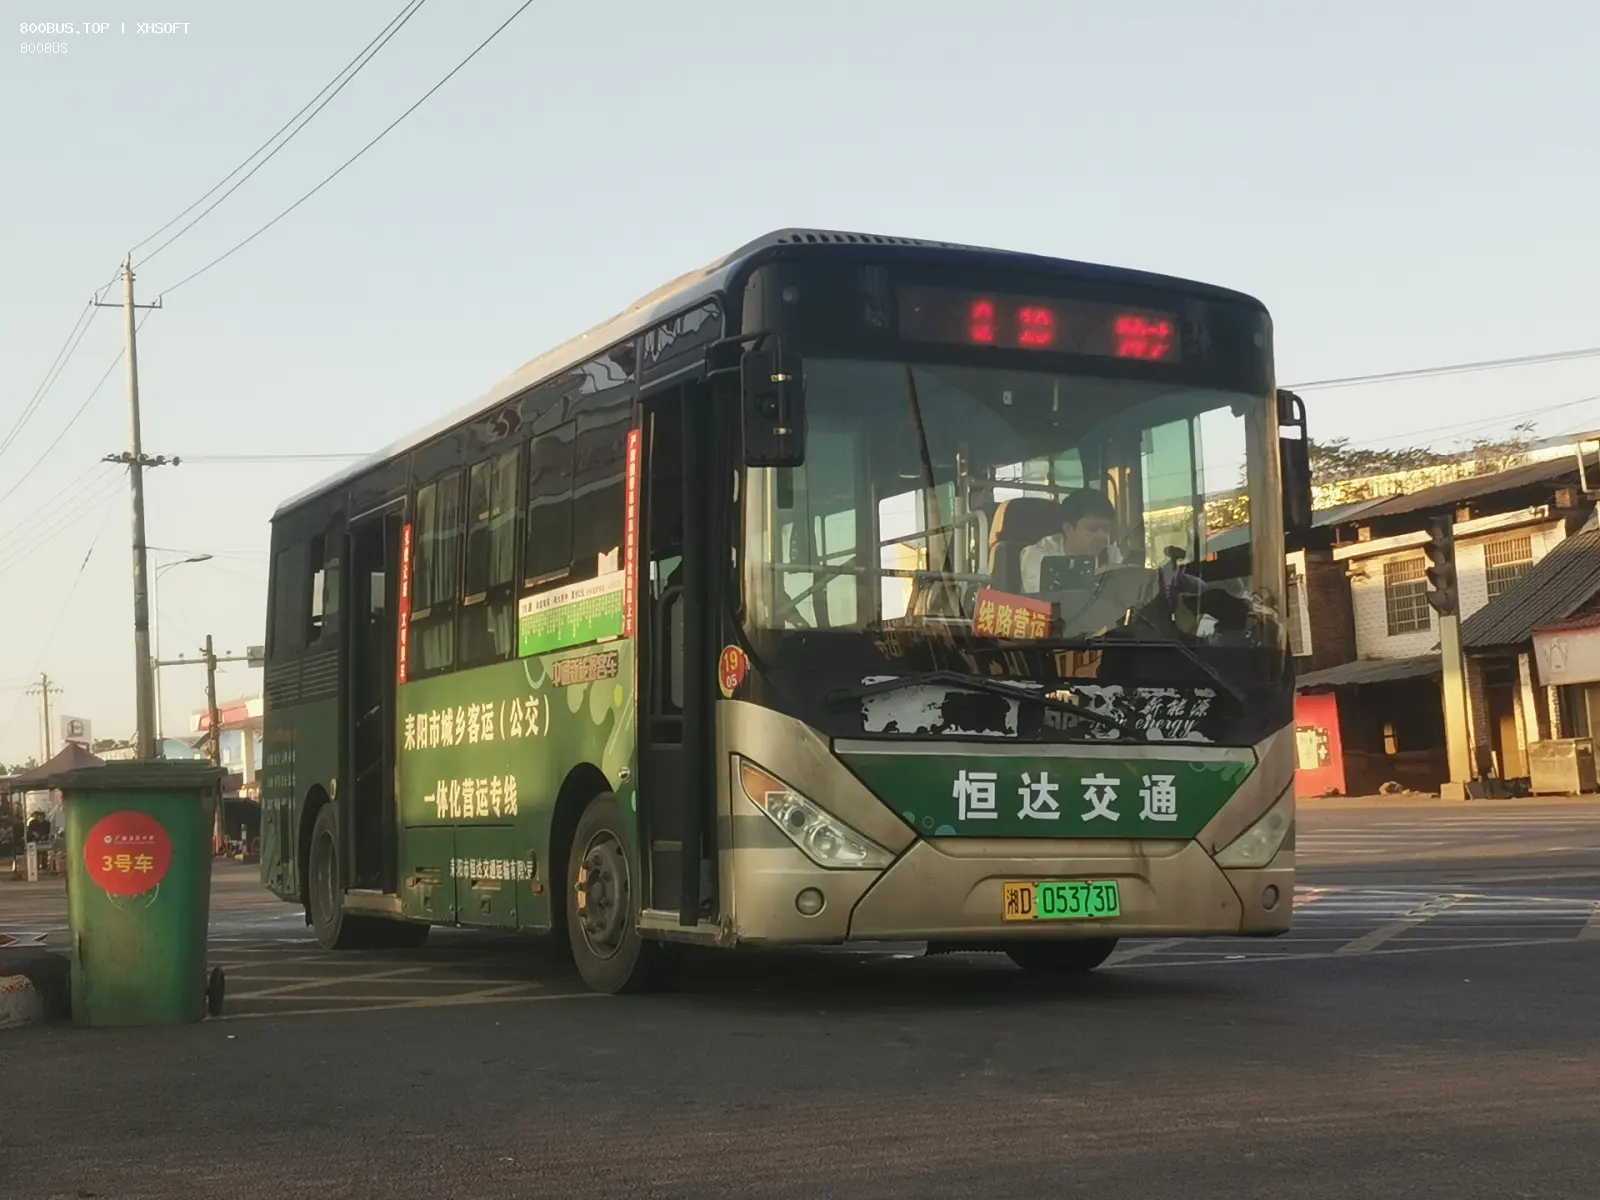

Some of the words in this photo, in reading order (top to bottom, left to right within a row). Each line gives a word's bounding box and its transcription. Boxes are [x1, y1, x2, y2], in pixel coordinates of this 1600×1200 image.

[978, 599, 1046, 639] 线路营运
[724, 650, 738, 672] 19
[424, 775, 518, 818] 一体化营运专线
[952, 769, 1178, 822] 恒达交通
[101, 853, 154, 874] 3号车
